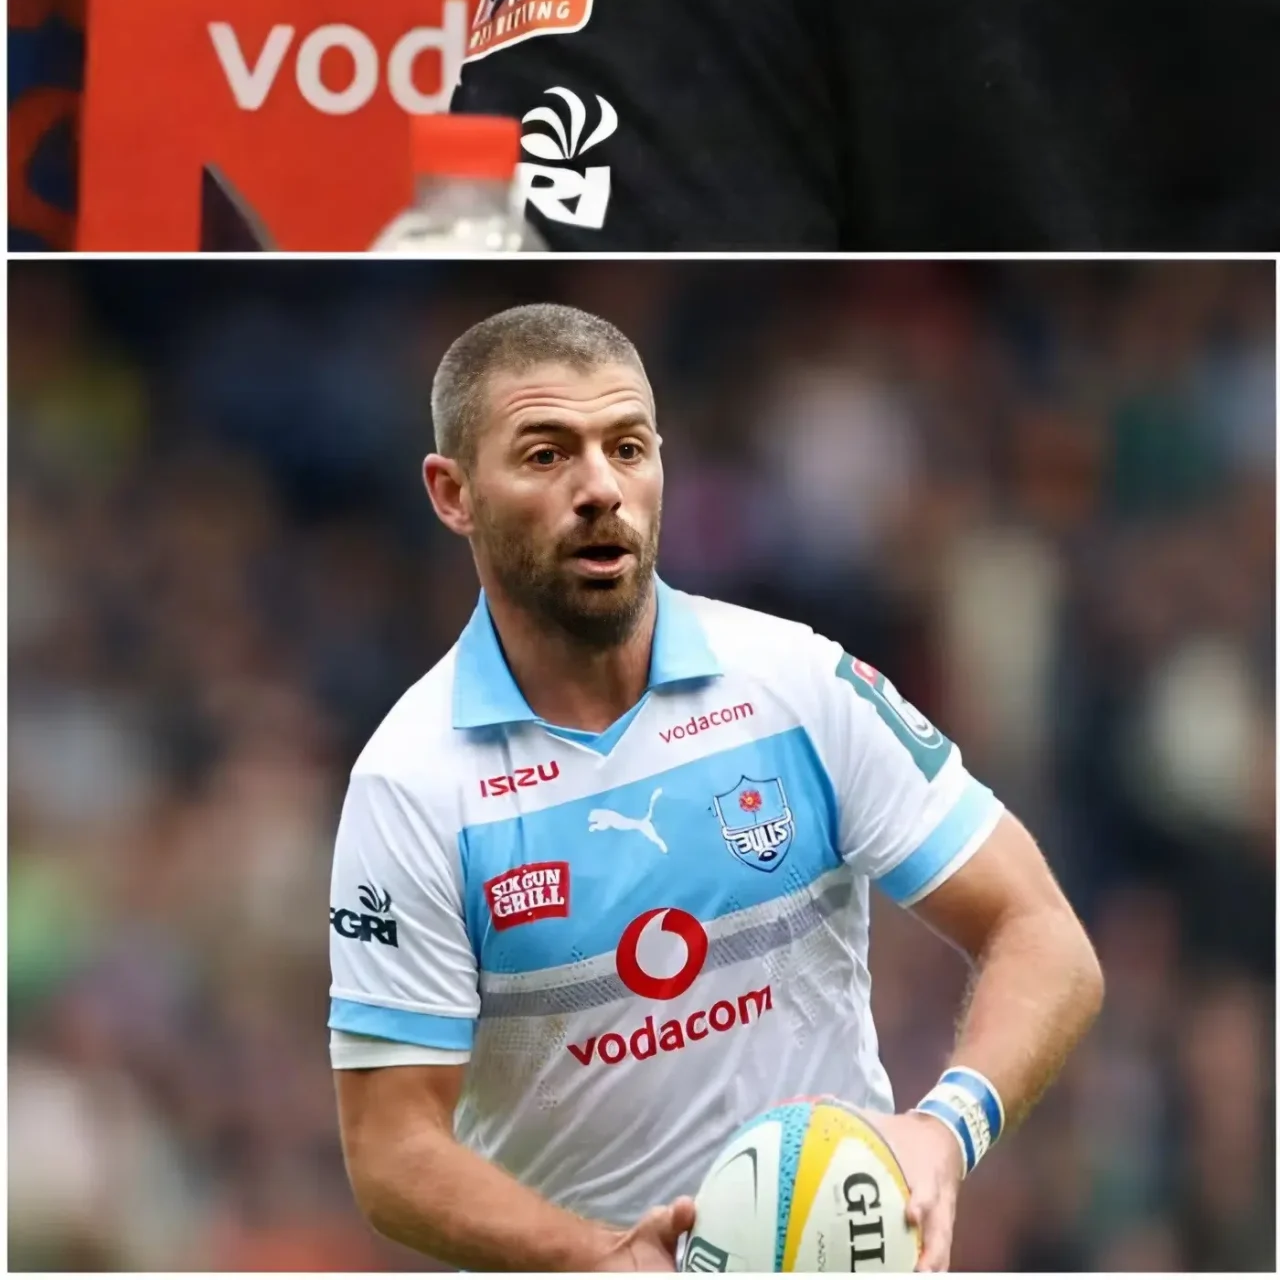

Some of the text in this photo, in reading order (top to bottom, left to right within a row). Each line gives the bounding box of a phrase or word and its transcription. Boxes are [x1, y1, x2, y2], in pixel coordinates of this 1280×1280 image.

[658, 701, 754, 744] vodacom
[736, 822, 788, 855] BULLS
[522, 869, 561, 894] GUN
[493, 885, 565, 918] GRILL
[330, 907, 399, 949] GRI
[566, 984, 774, 1067] vodacom
